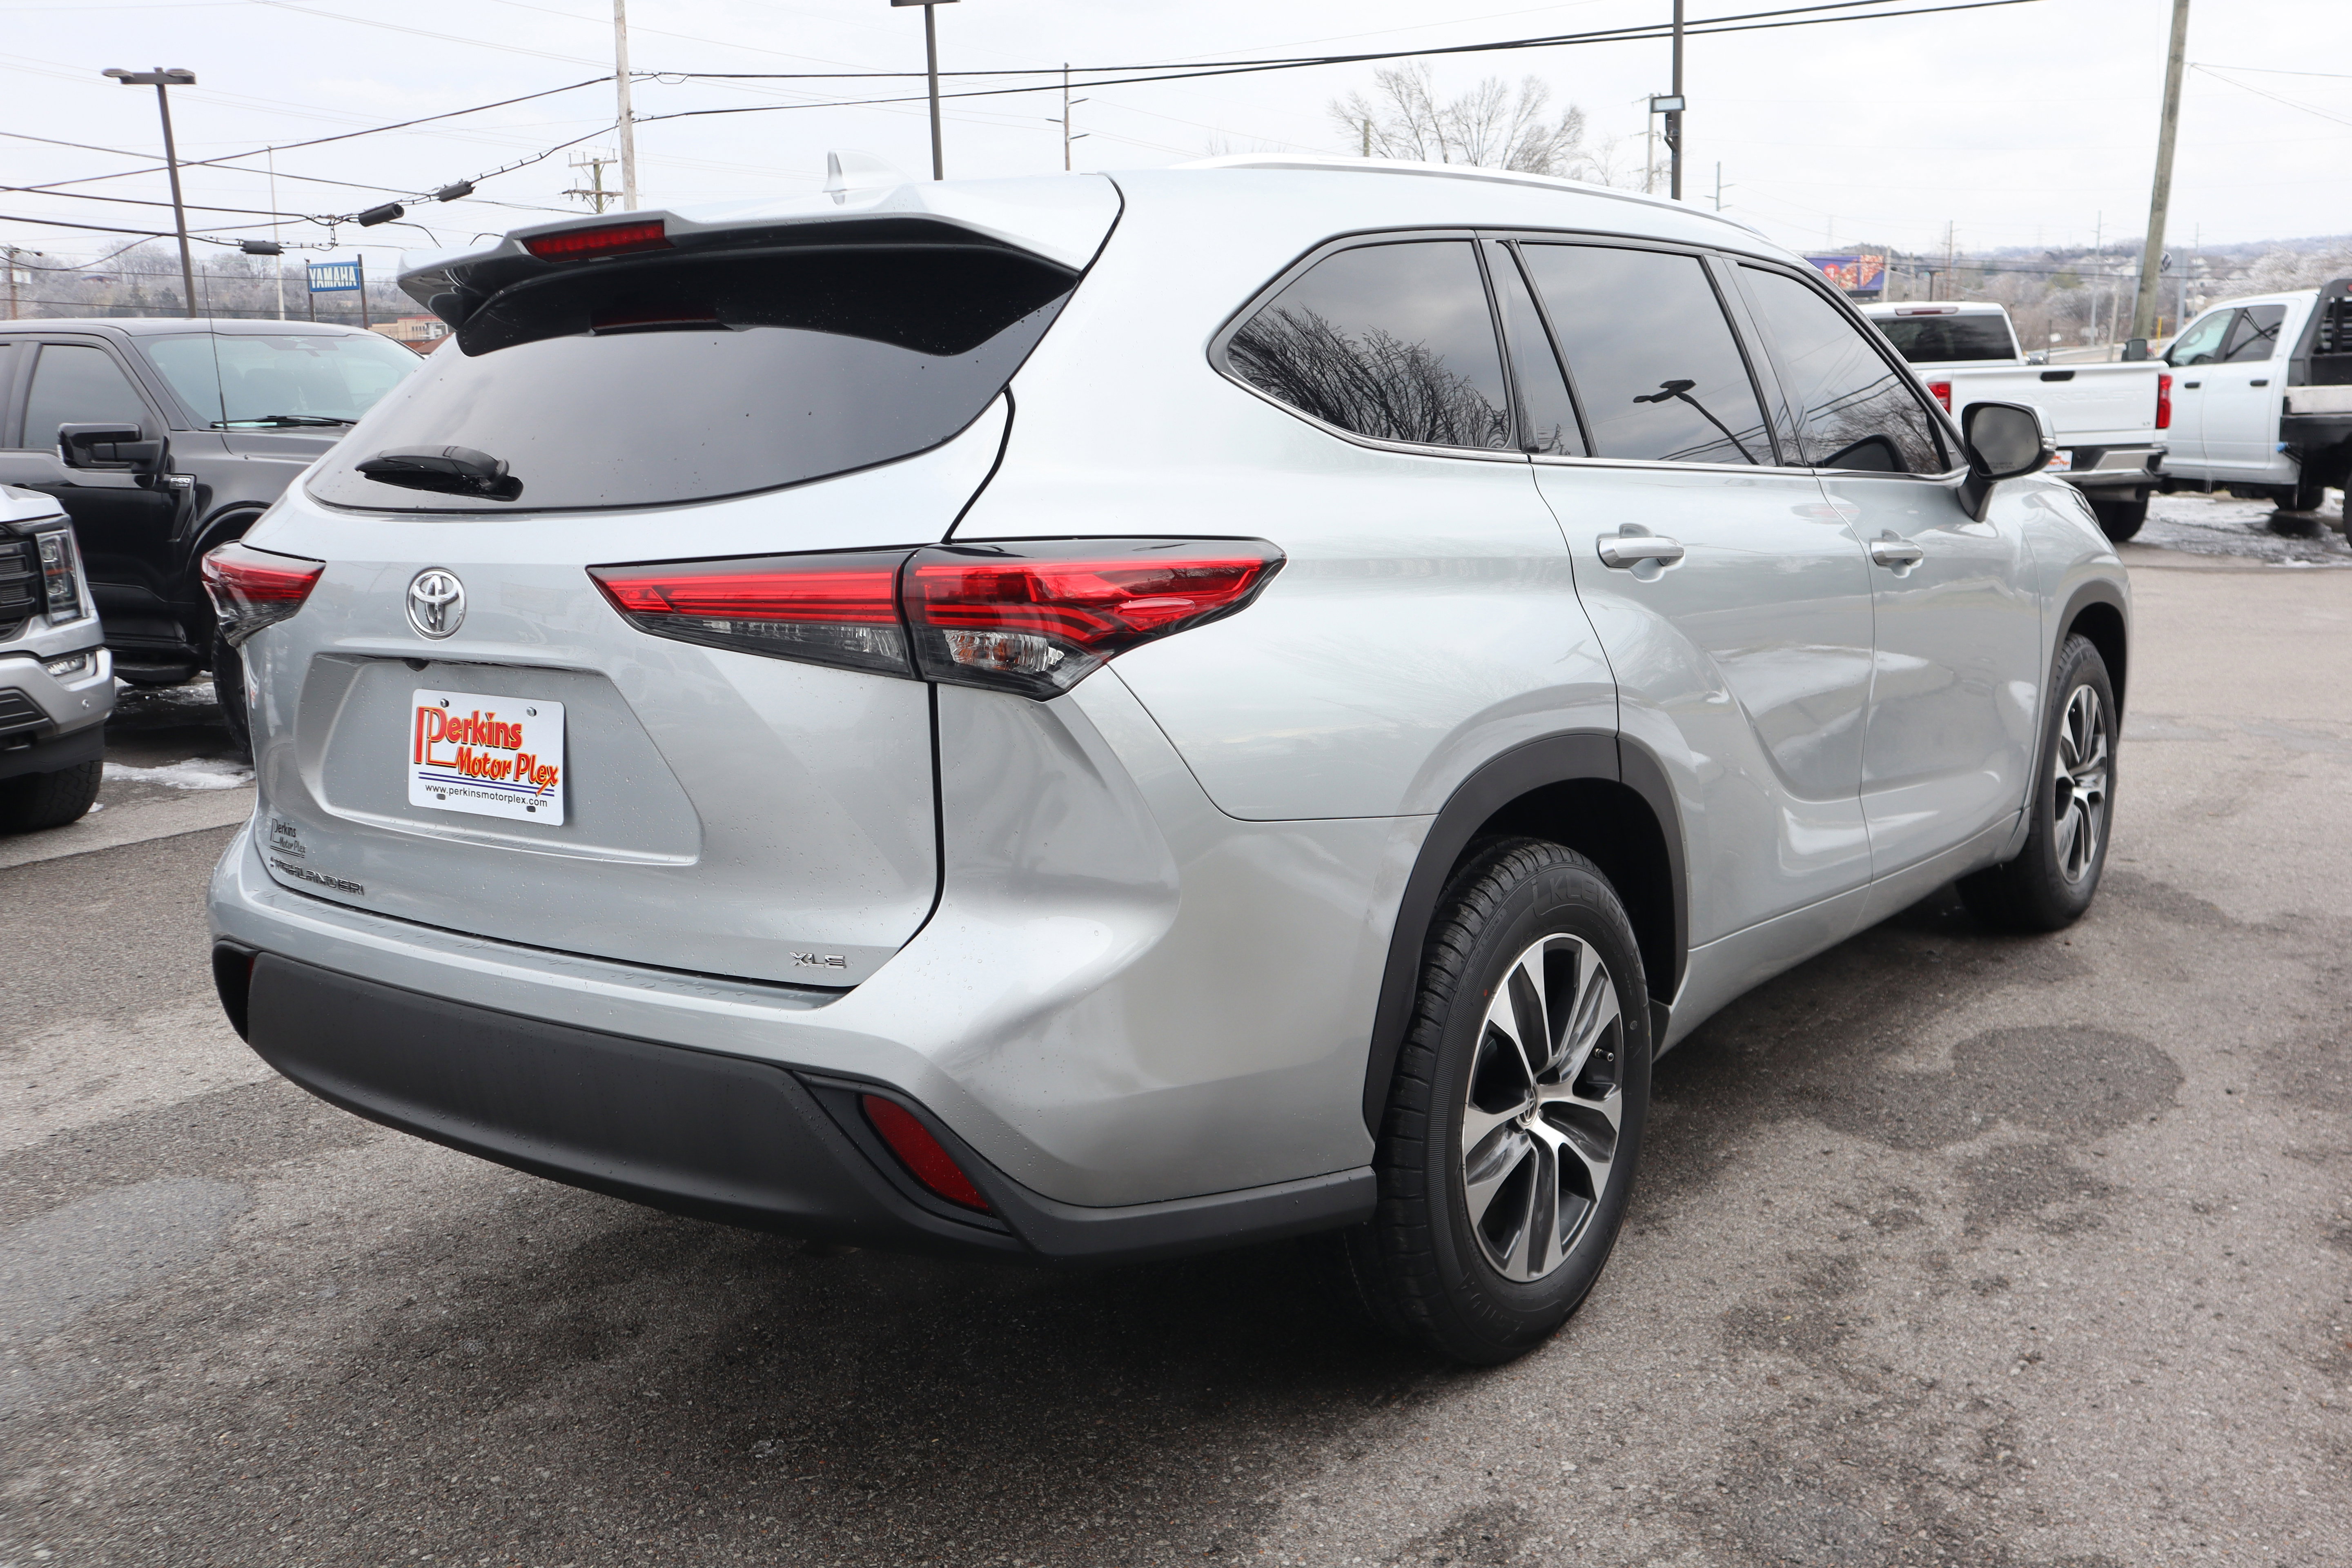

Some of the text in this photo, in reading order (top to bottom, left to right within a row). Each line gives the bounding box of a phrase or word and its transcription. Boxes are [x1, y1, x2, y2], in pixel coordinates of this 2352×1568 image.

[309, 266, 357, 288] YAMAHA
[414, 706, 523, 764] Perkins
[455, 746, 559, 797] Motor Plex
[425, 784, 548, 807] www.perkinsmotorplex.com
[270, 818, 296, 841] Perkins
[280, 836, 294, 849] Motor
[270, 856, 365, 895] HIGHLANDER
[789, 952, 846, 969] XLE
